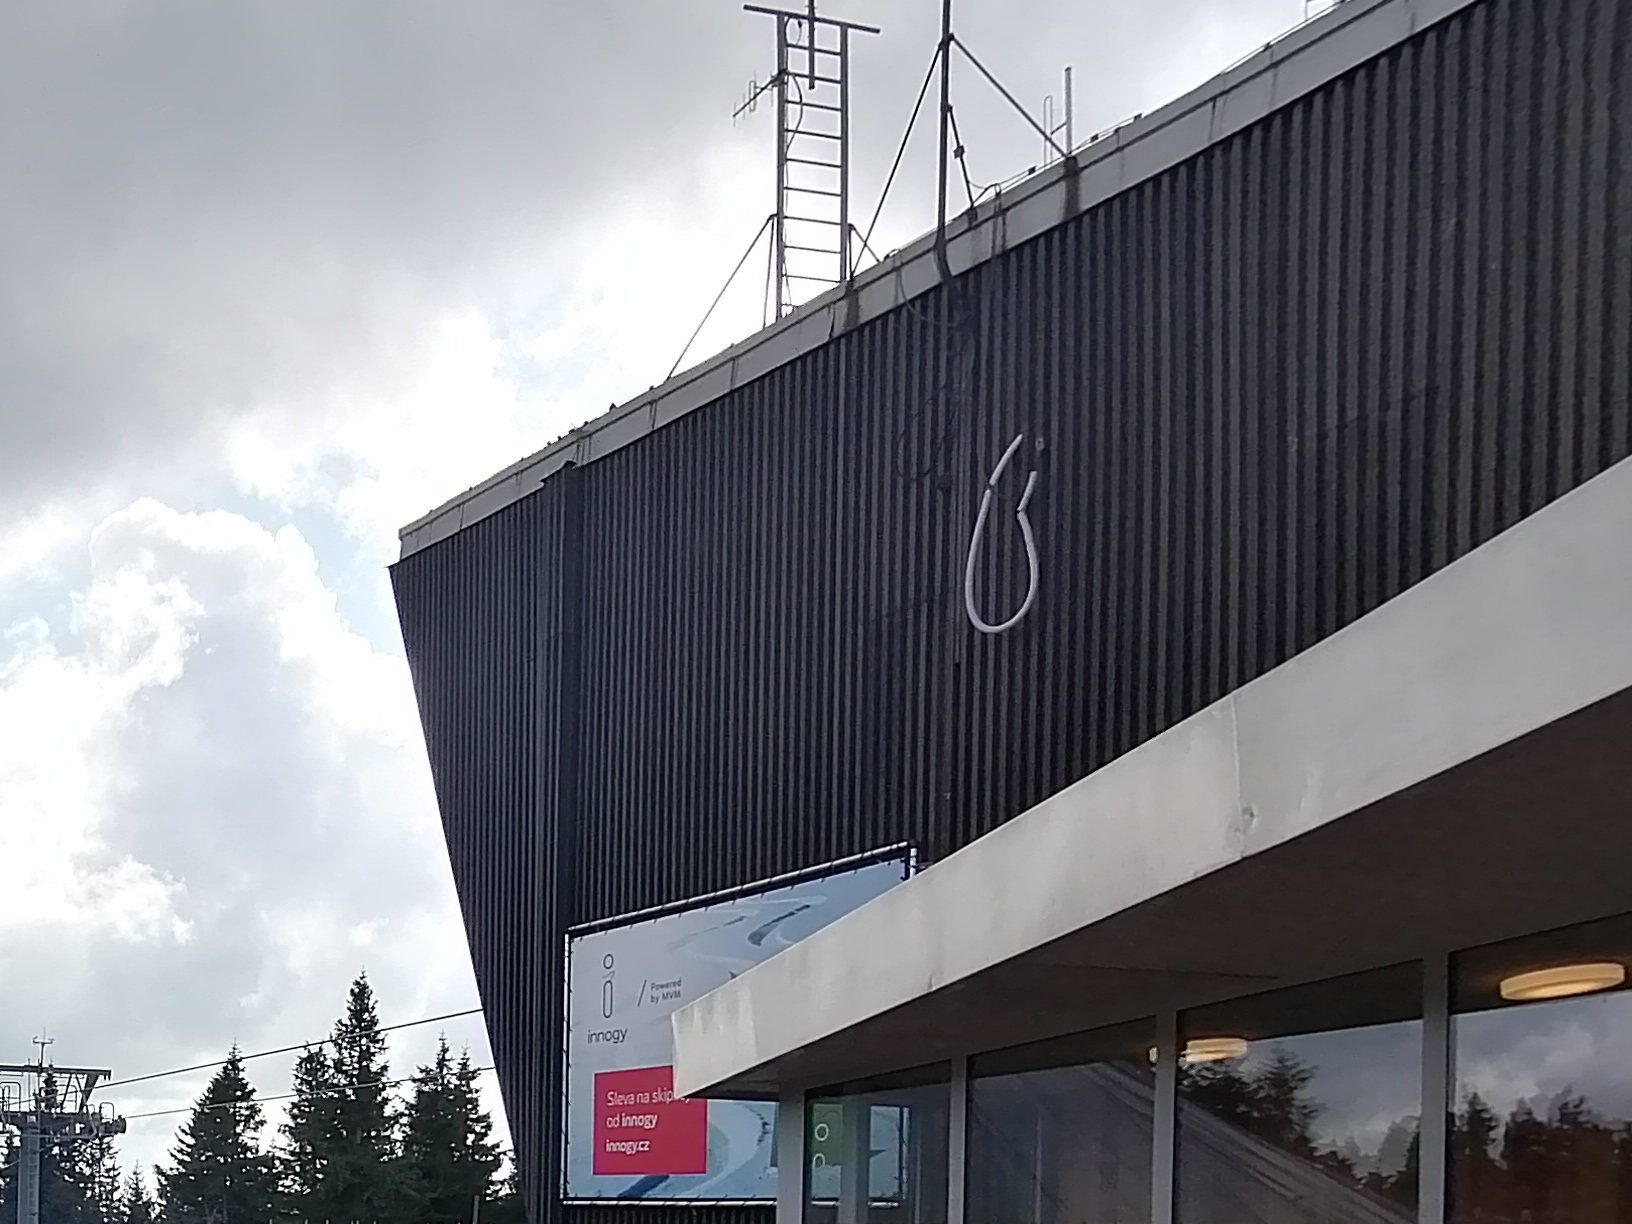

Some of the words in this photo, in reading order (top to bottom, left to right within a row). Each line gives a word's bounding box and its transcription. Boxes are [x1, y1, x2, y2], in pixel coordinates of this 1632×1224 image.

[650, 977, 682, 991] Powered
[650, 994, 660, 1005] by
[661, 990, 682, 1001] MVM
[587, 1028, 628, 1044] innogy
[606, 1091, 635, 1106] Sleva
[636, 1092, 650, 1104] na
[606, 1113, 620, 1128] od
[621, 1112, 658, 1129] innogy
[605, 1139, 650, 1155] innogy.cz
